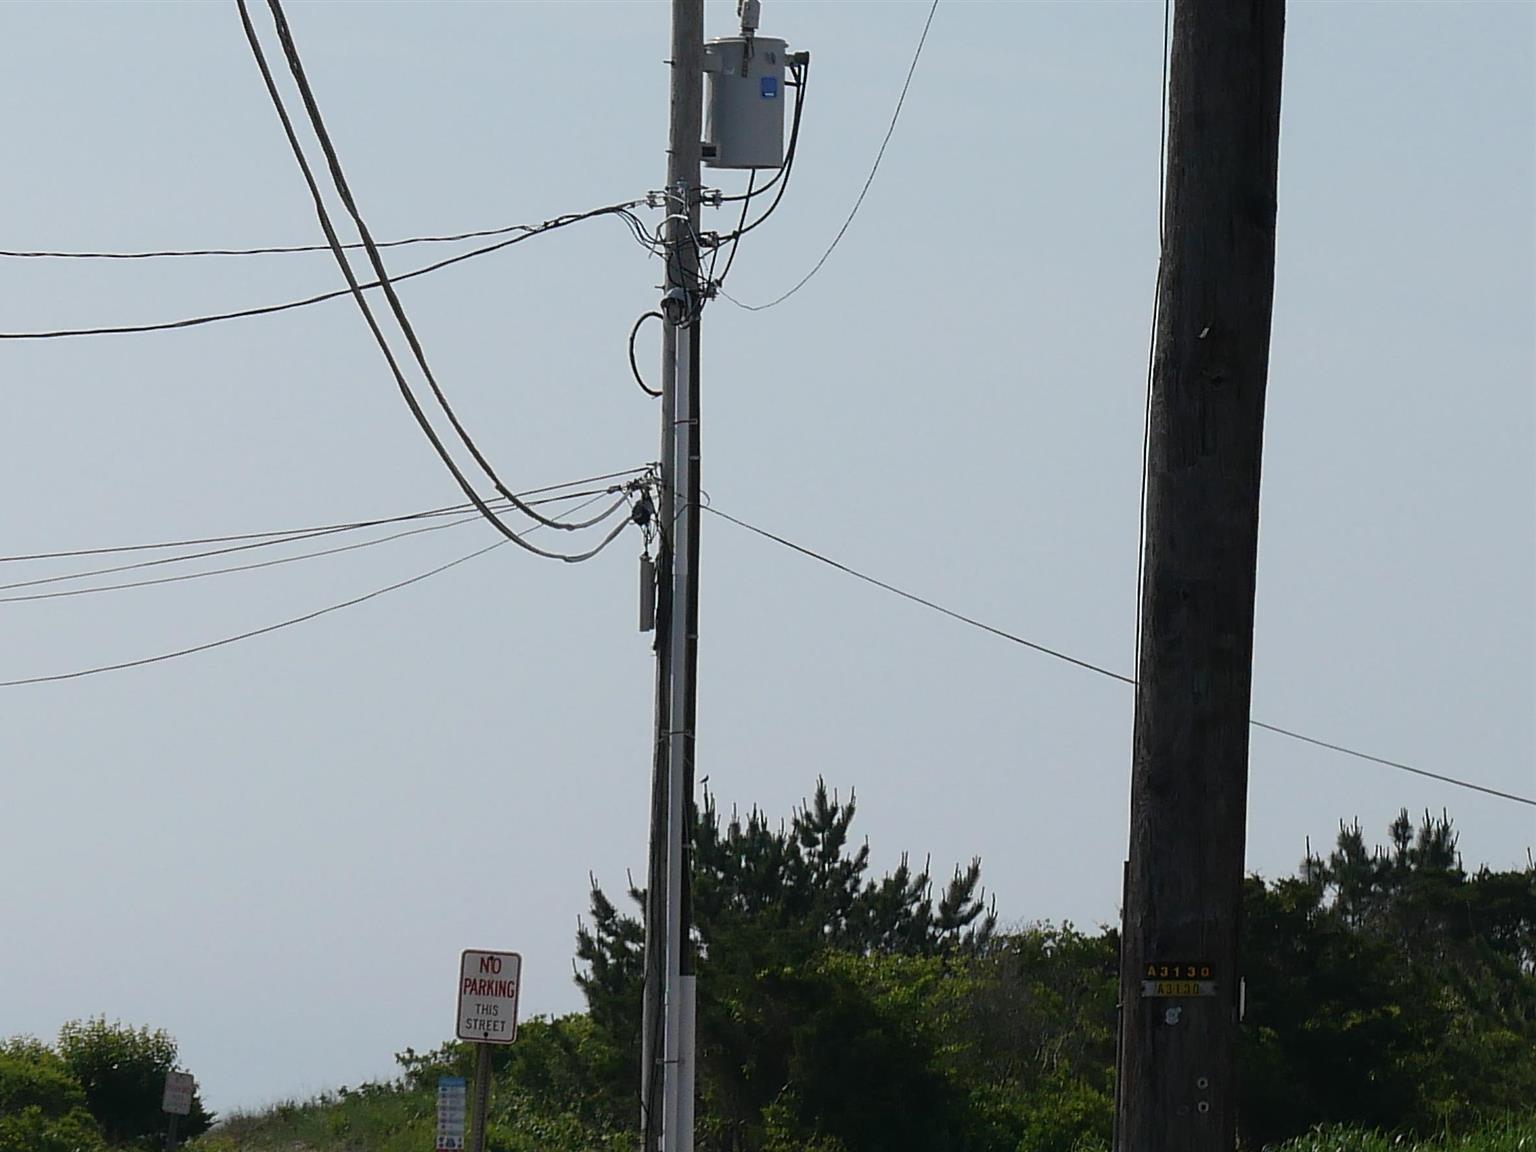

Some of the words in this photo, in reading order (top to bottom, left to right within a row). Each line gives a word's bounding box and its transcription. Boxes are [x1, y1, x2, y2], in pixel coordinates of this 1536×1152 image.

[480, 957, 502, 974] NO
[1147, 965, 1212, 977] A3130
[464, 978, 515, 998] PARKING
[475, 1003, 500, 1016] THIS
[465, 1018, 506, 1032] STREET
